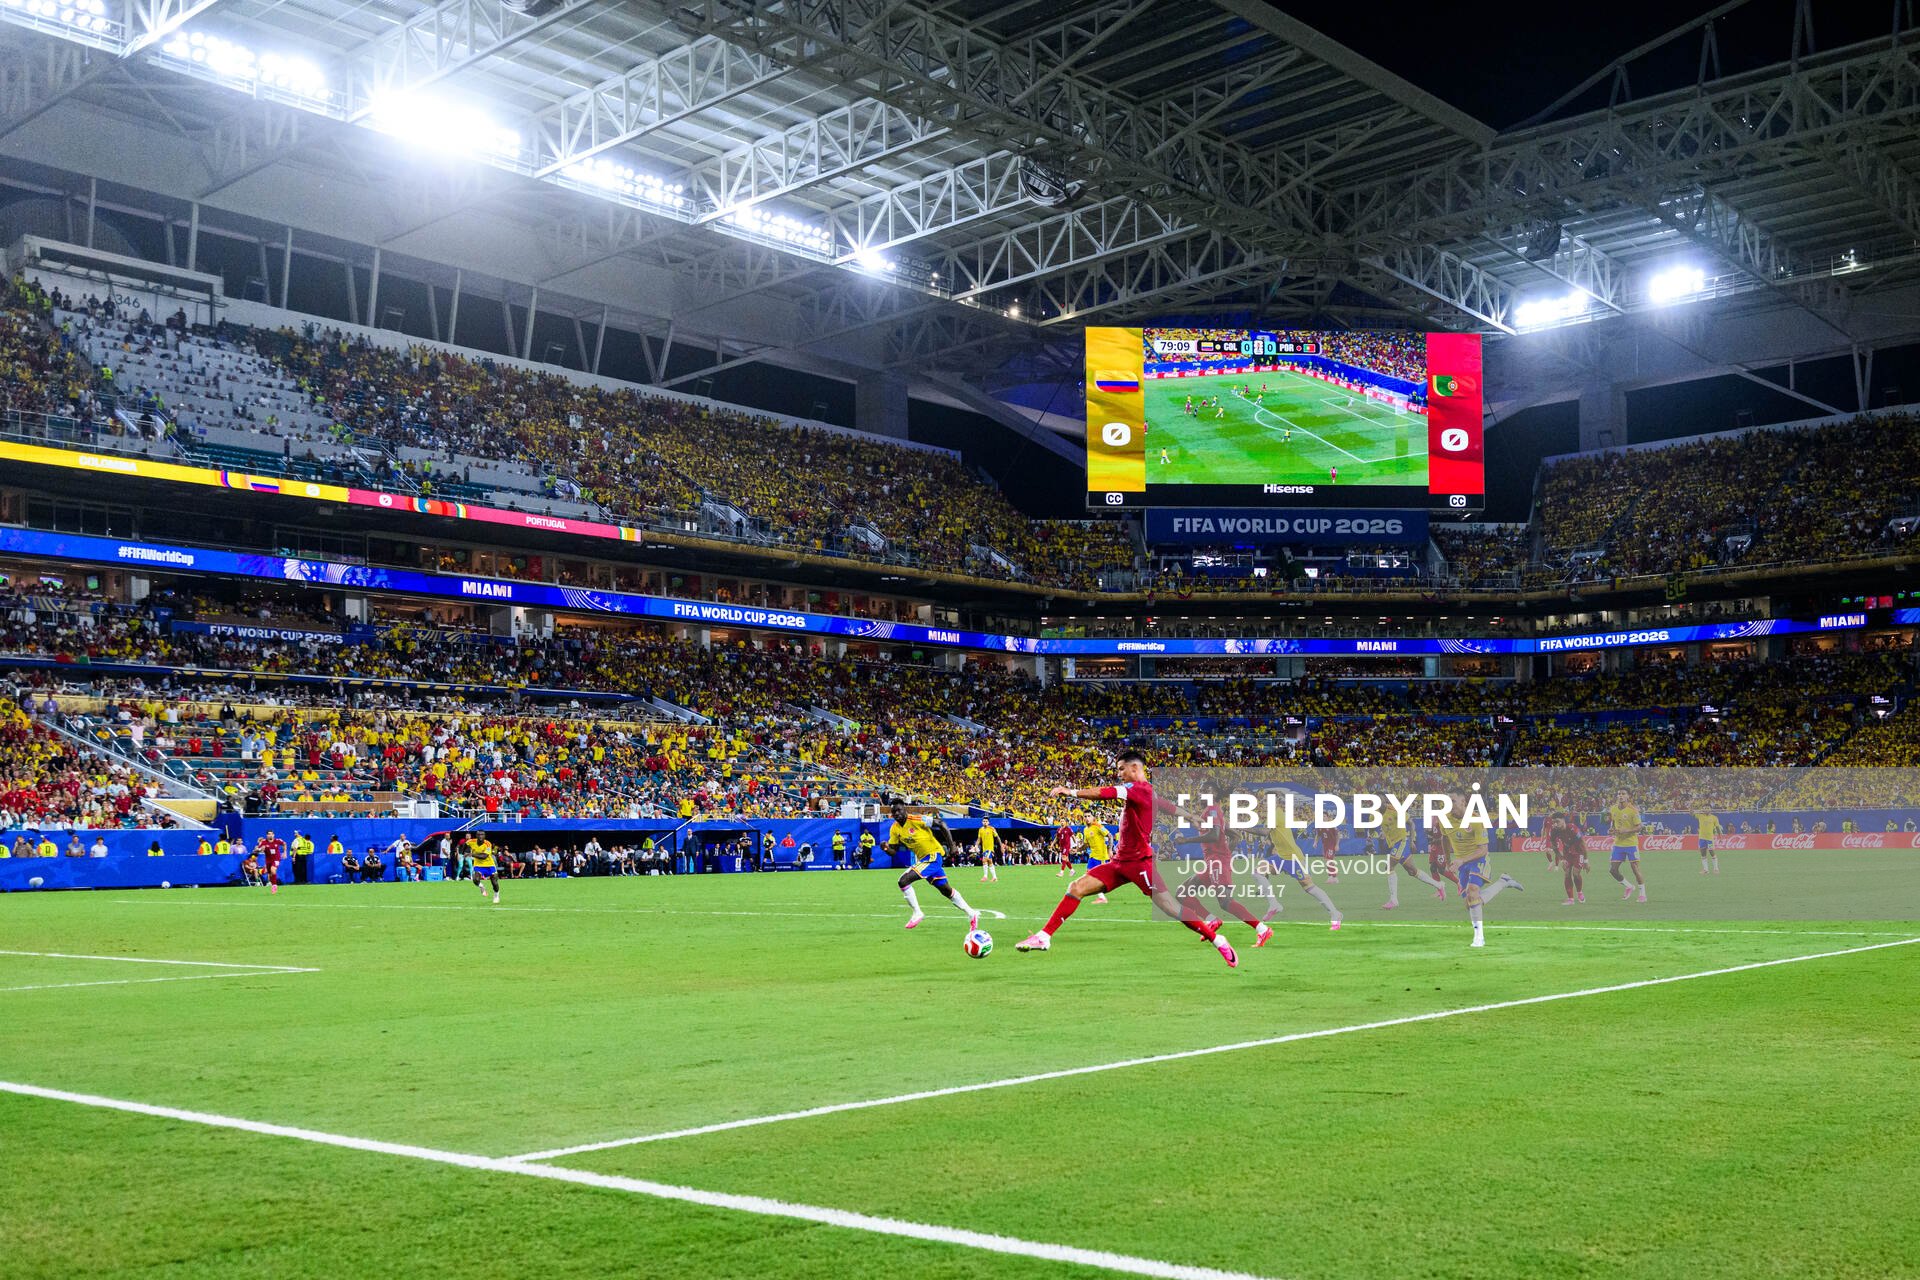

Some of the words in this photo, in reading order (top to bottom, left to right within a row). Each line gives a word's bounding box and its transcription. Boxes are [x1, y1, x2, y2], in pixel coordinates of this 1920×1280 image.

[115, 294, 140, 308] 346
[1160, 341, 1190, 351] 79:09
[1223, 342, 1238, 351] COL
[1244, 343, 1250, 352] 0
[1267, 343, 1273, 352] 0
[1279, 343, 1294, 352] POR
[1263, 483, 1314, 494] Hisense
[1107, 494, 1122, 504] CC
[1451, 496, 1466, 506] CC
[525, 516, 567, 530] PORTUGAL
[1173, 517, 1216, 533] FIFA
[1218, 518, 1290, 534] WORLD
[1293, 518, 1332, 534] CUP
[1335, 519, 1404, 534] 2026
[118, 546, 194, 566] #FIFAWorldCup
[462, 581, 512, 598] MIAMI
[674, 603, 700, 618] FIFA
[700, 606, 743, 622] WORLD
[743, 611, 767, 625] CUP
[767, 613, 806, 628] 2026
[1820, 615, 1865, 628] MIAMI
[237, 627, 279, 639] WORLD
[280, 631, 303, 641] CUP
[928, 629, 960, 643] MIAMI
[1540, 639, 1563, 651] FIFA
[1563, 637, 1604, 649] WORLD
[1605, 633, 1628, 645] CUP
[1628, 630, 1670, 642] 2026
[1117, 642, 1166, 652] #FIFAWorldCup
[1356, 641, 1397, 651] MIAMI
[1642, 835, 1683, 850] Coca-Cola
[1771, 833, 1817, 849] Coca-Cola
[1841, 833, 1885, 849] Coca-Cola
